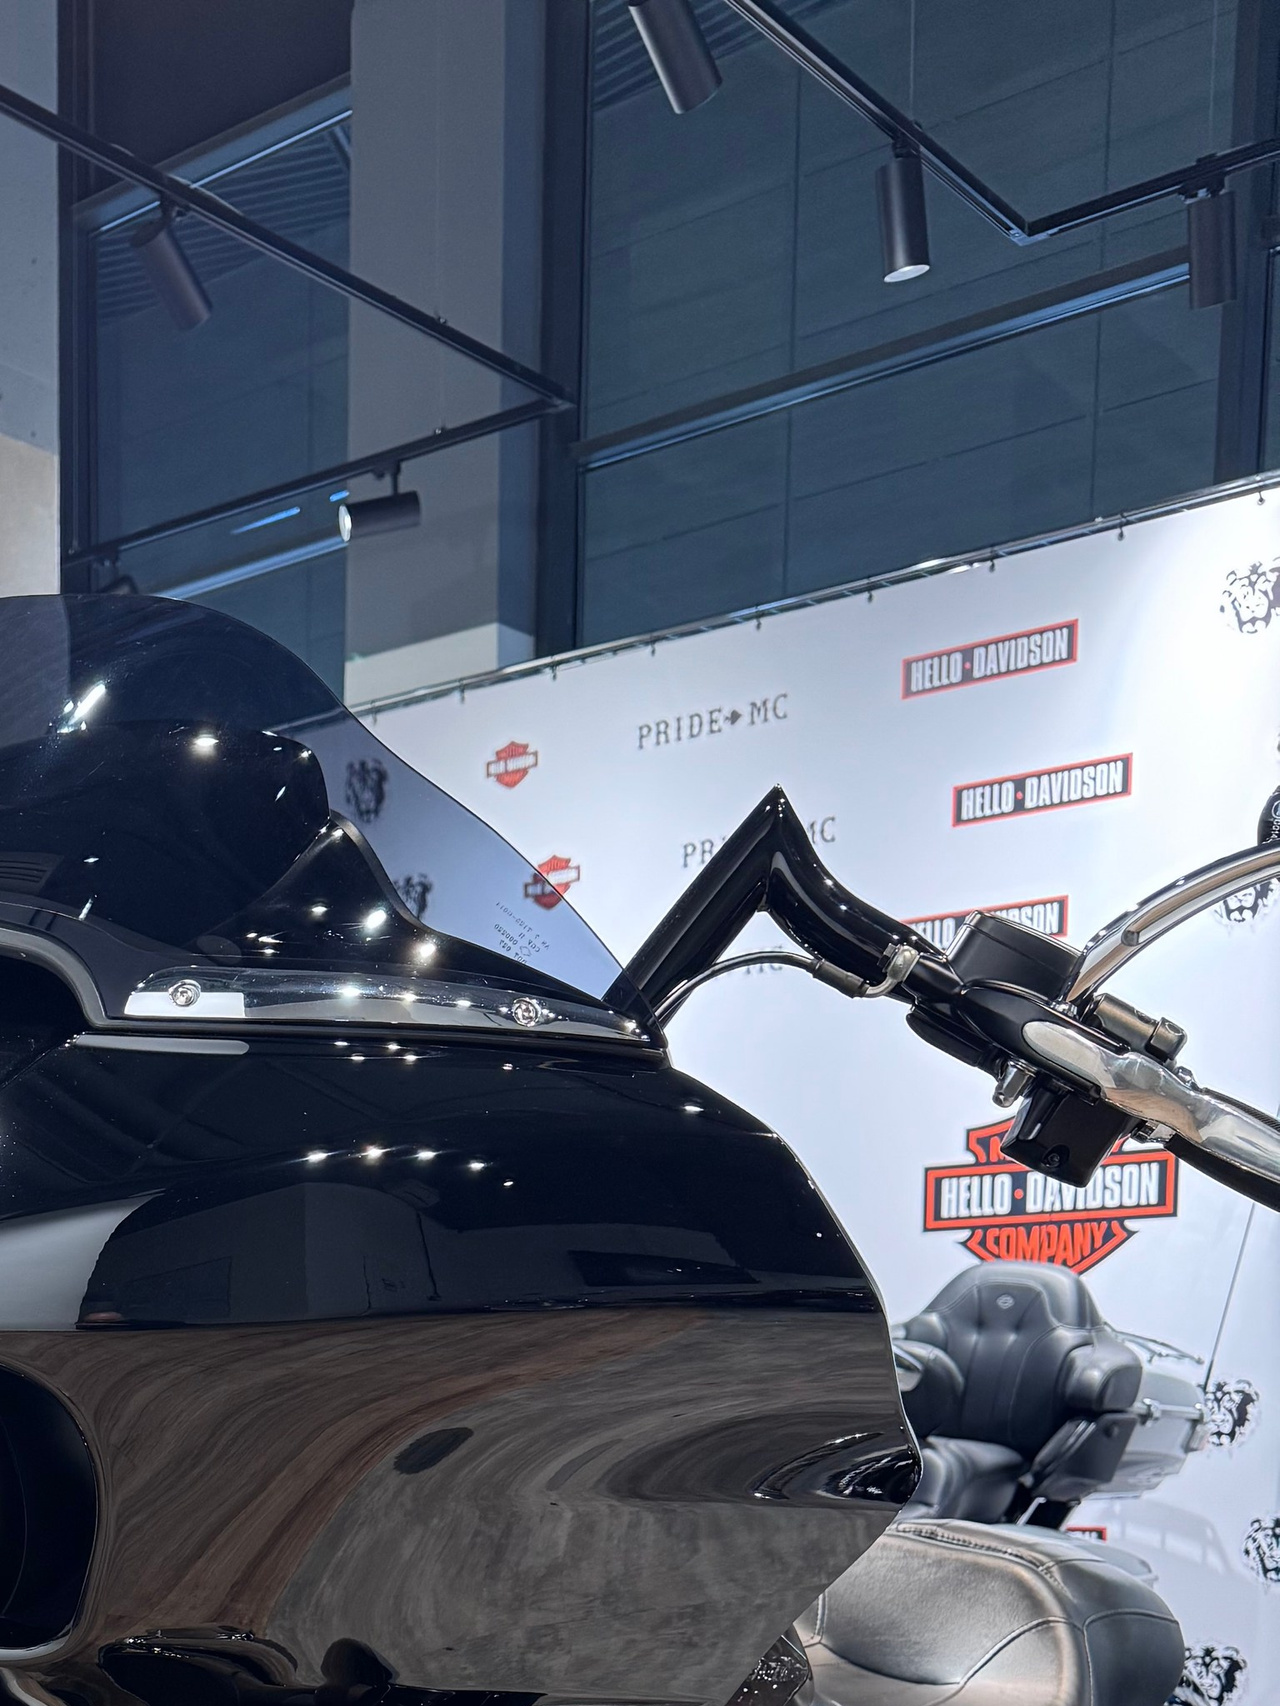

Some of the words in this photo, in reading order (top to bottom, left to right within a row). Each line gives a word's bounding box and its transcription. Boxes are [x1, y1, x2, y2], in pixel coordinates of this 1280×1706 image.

[910, 651, 963, 692] HELLO
[972, 627, 1069, 679] DAVIDSON
[637, 706, 723, 750] PRIDE
[747, 692, 788, 727] MC
[960, 780, 1015, 821] HELLO
[1024, 759, 1124, 809] DAVIDSON
[939, 1173, 1013, 1219] HELLO
[1025, 1162, 1160, 1214] DAVIDSON
[985, 1220, 1108, 1268] COMPANY
